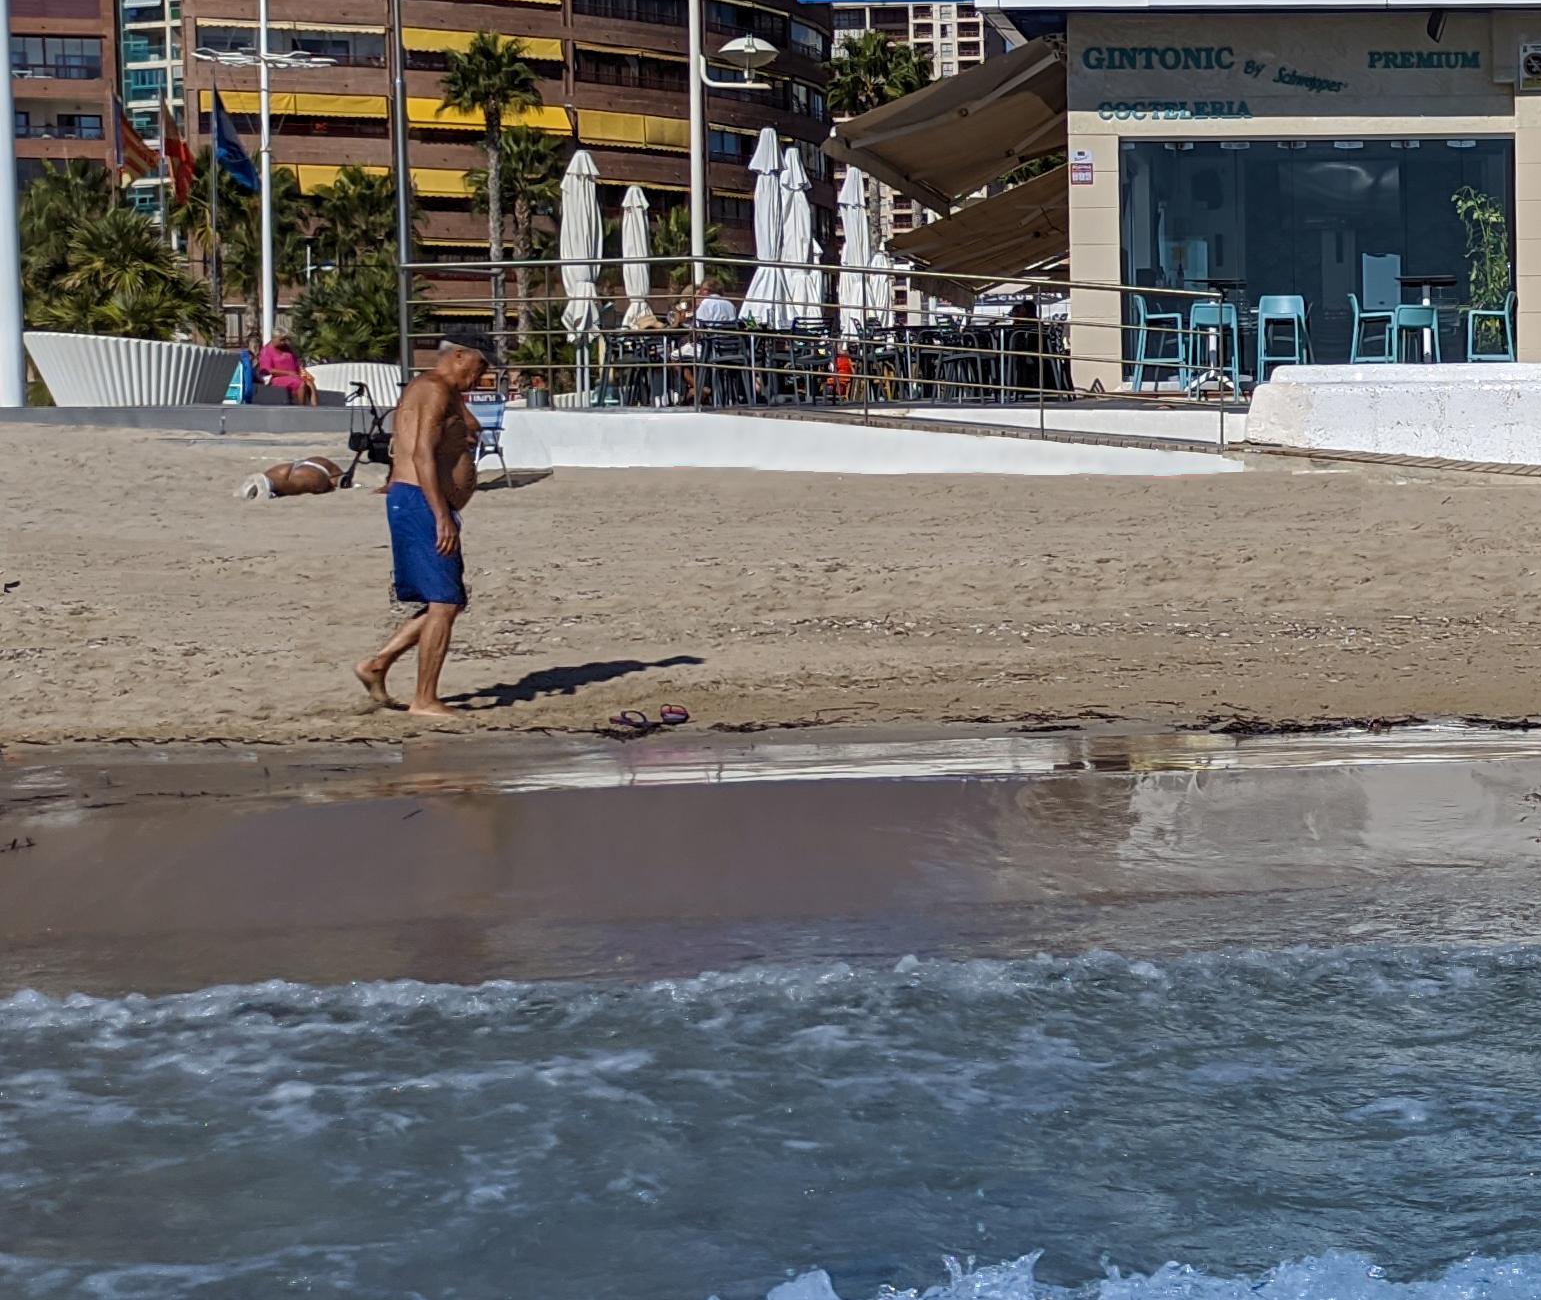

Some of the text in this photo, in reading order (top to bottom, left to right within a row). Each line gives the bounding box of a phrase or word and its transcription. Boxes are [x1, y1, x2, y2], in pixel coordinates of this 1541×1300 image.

[1082, 46, 1235, 70] GINTONIC
[1243, 60, 1266, 78] By
[1367, 51, 1481, 69] PREMIUM
[1098, 100, 1253, 121] COCTELERIA
